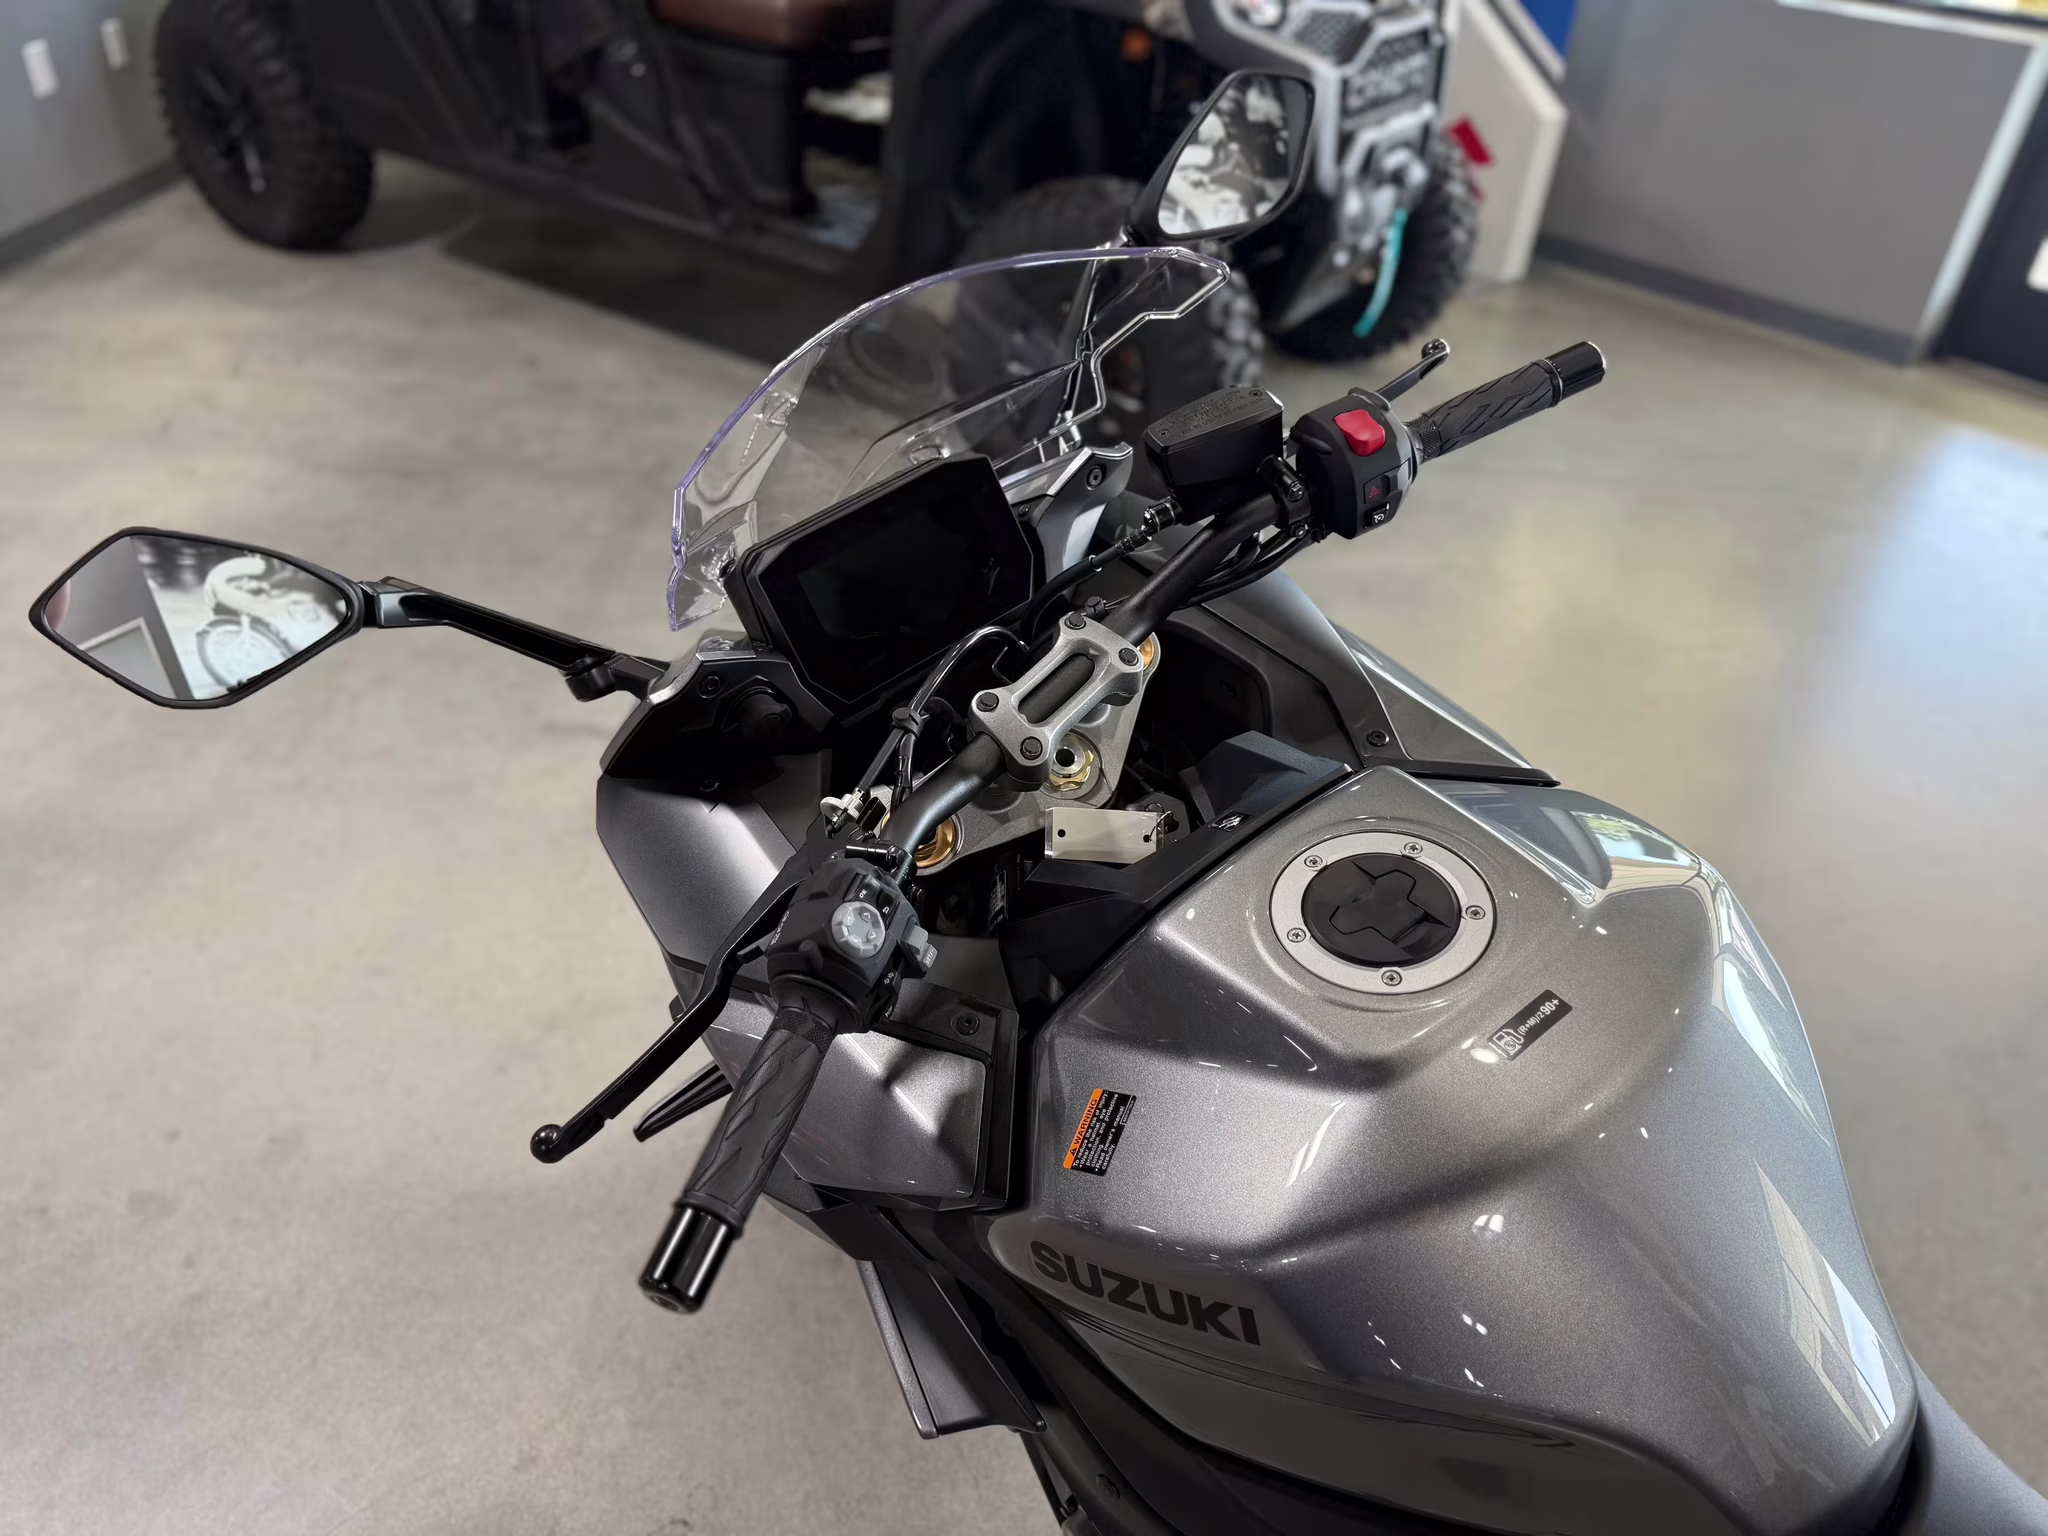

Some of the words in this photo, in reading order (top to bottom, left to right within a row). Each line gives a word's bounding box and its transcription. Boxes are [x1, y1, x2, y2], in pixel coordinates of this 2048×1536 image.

[859, 889, 867, 898] OK
[1074, 1099, 1098, 1144] WARNING
[1080, 1150, 1089, 1164] Wear
[1099, 1109, 1107, 1119] eye
[1086, 1135, 1101, 1166] protection,
[1104, 1094, 1119, 1121] protective
[1095, 1153, 1105, 1168] Read
[1103, 1129, 1115, 1150] owner's
[1113, 1106, 1125, 1126] manual
[1077, 1140, 1088, 1158] reduce
[1101, 1143, 1116, 1169] carefully.
[1030, 1241, 1261, 1346] SUZUKI
